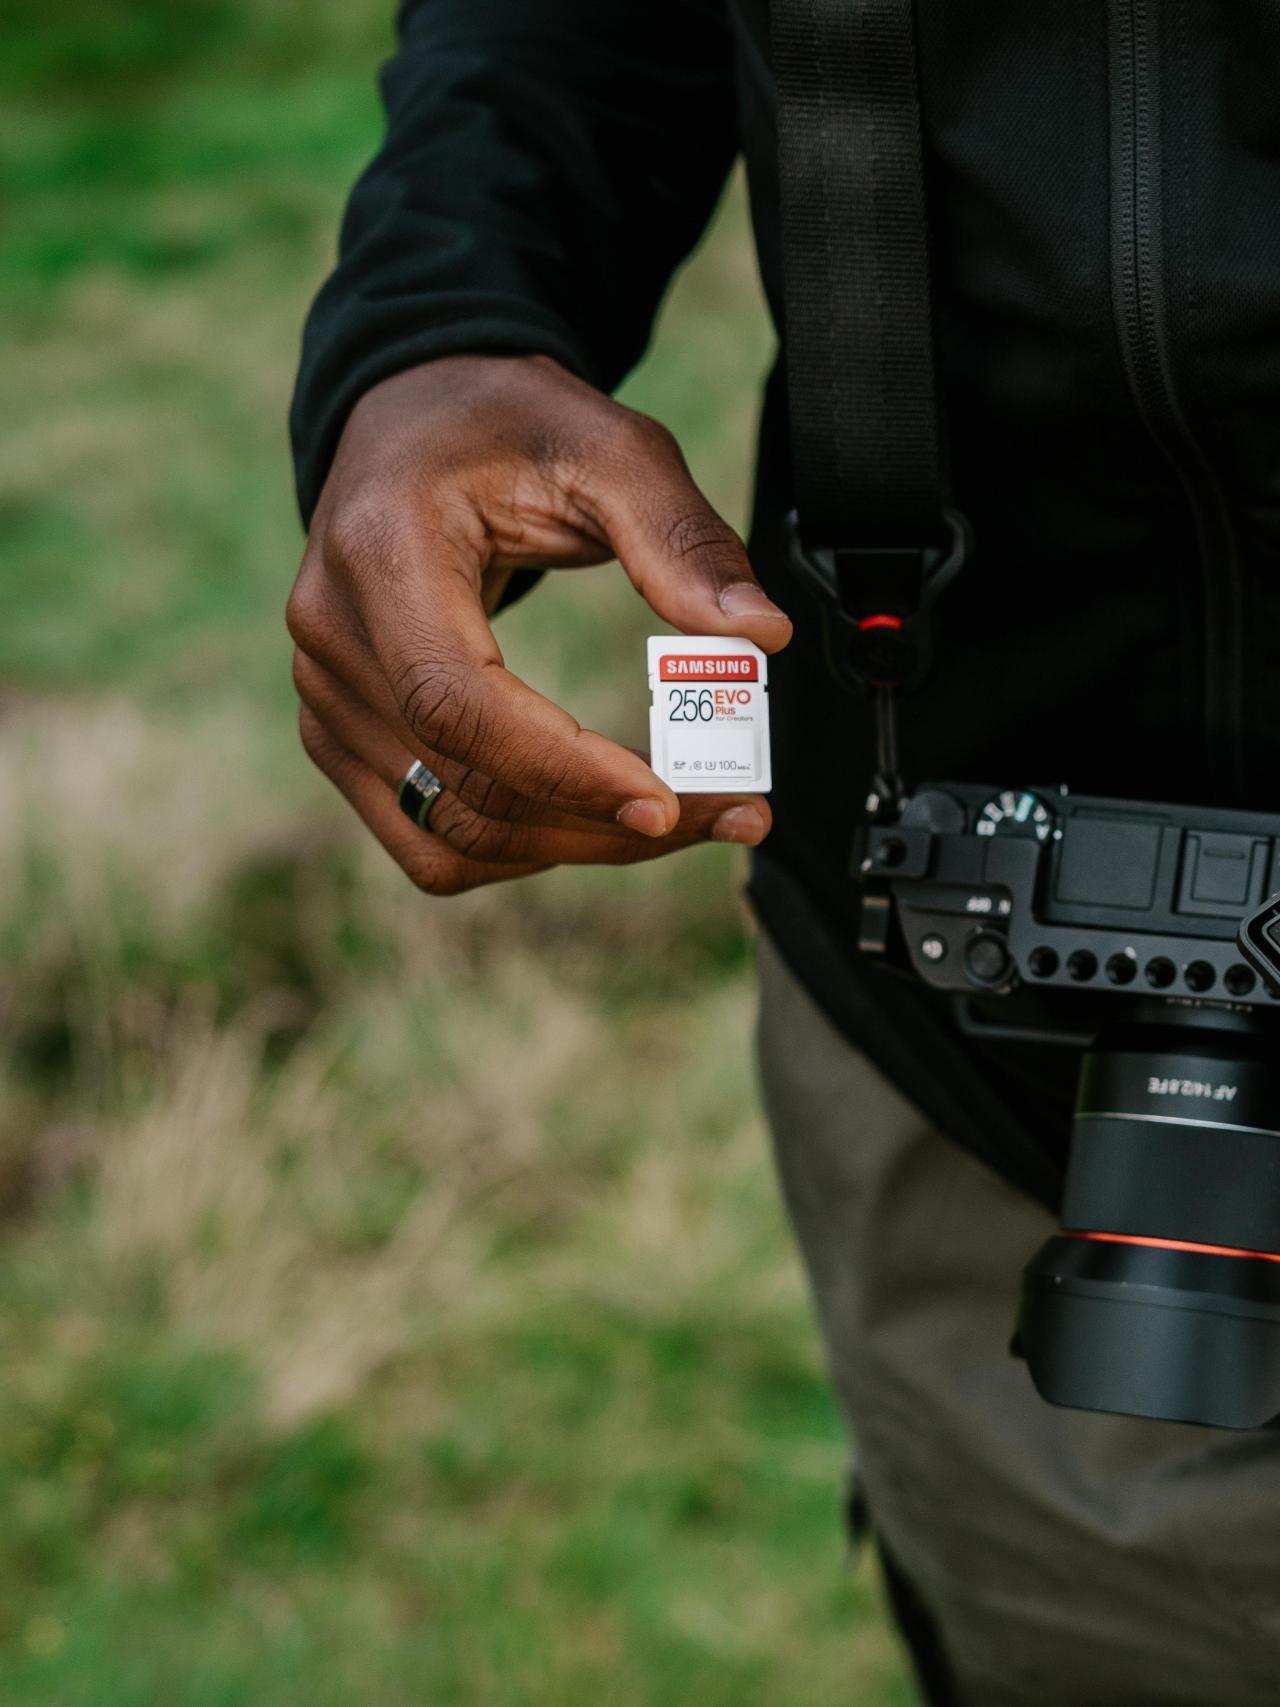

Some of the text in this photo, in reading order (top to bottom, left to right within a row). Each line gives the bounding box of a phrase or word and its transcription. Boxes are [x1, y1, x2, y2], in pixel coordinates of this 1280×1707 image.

[666, 659, 751, 674] SAMSUNG
[669, 689, 752, 722] 256 EVO
[715, 706, 736, 715] Plus
[719, 760, 737, 770] 100
